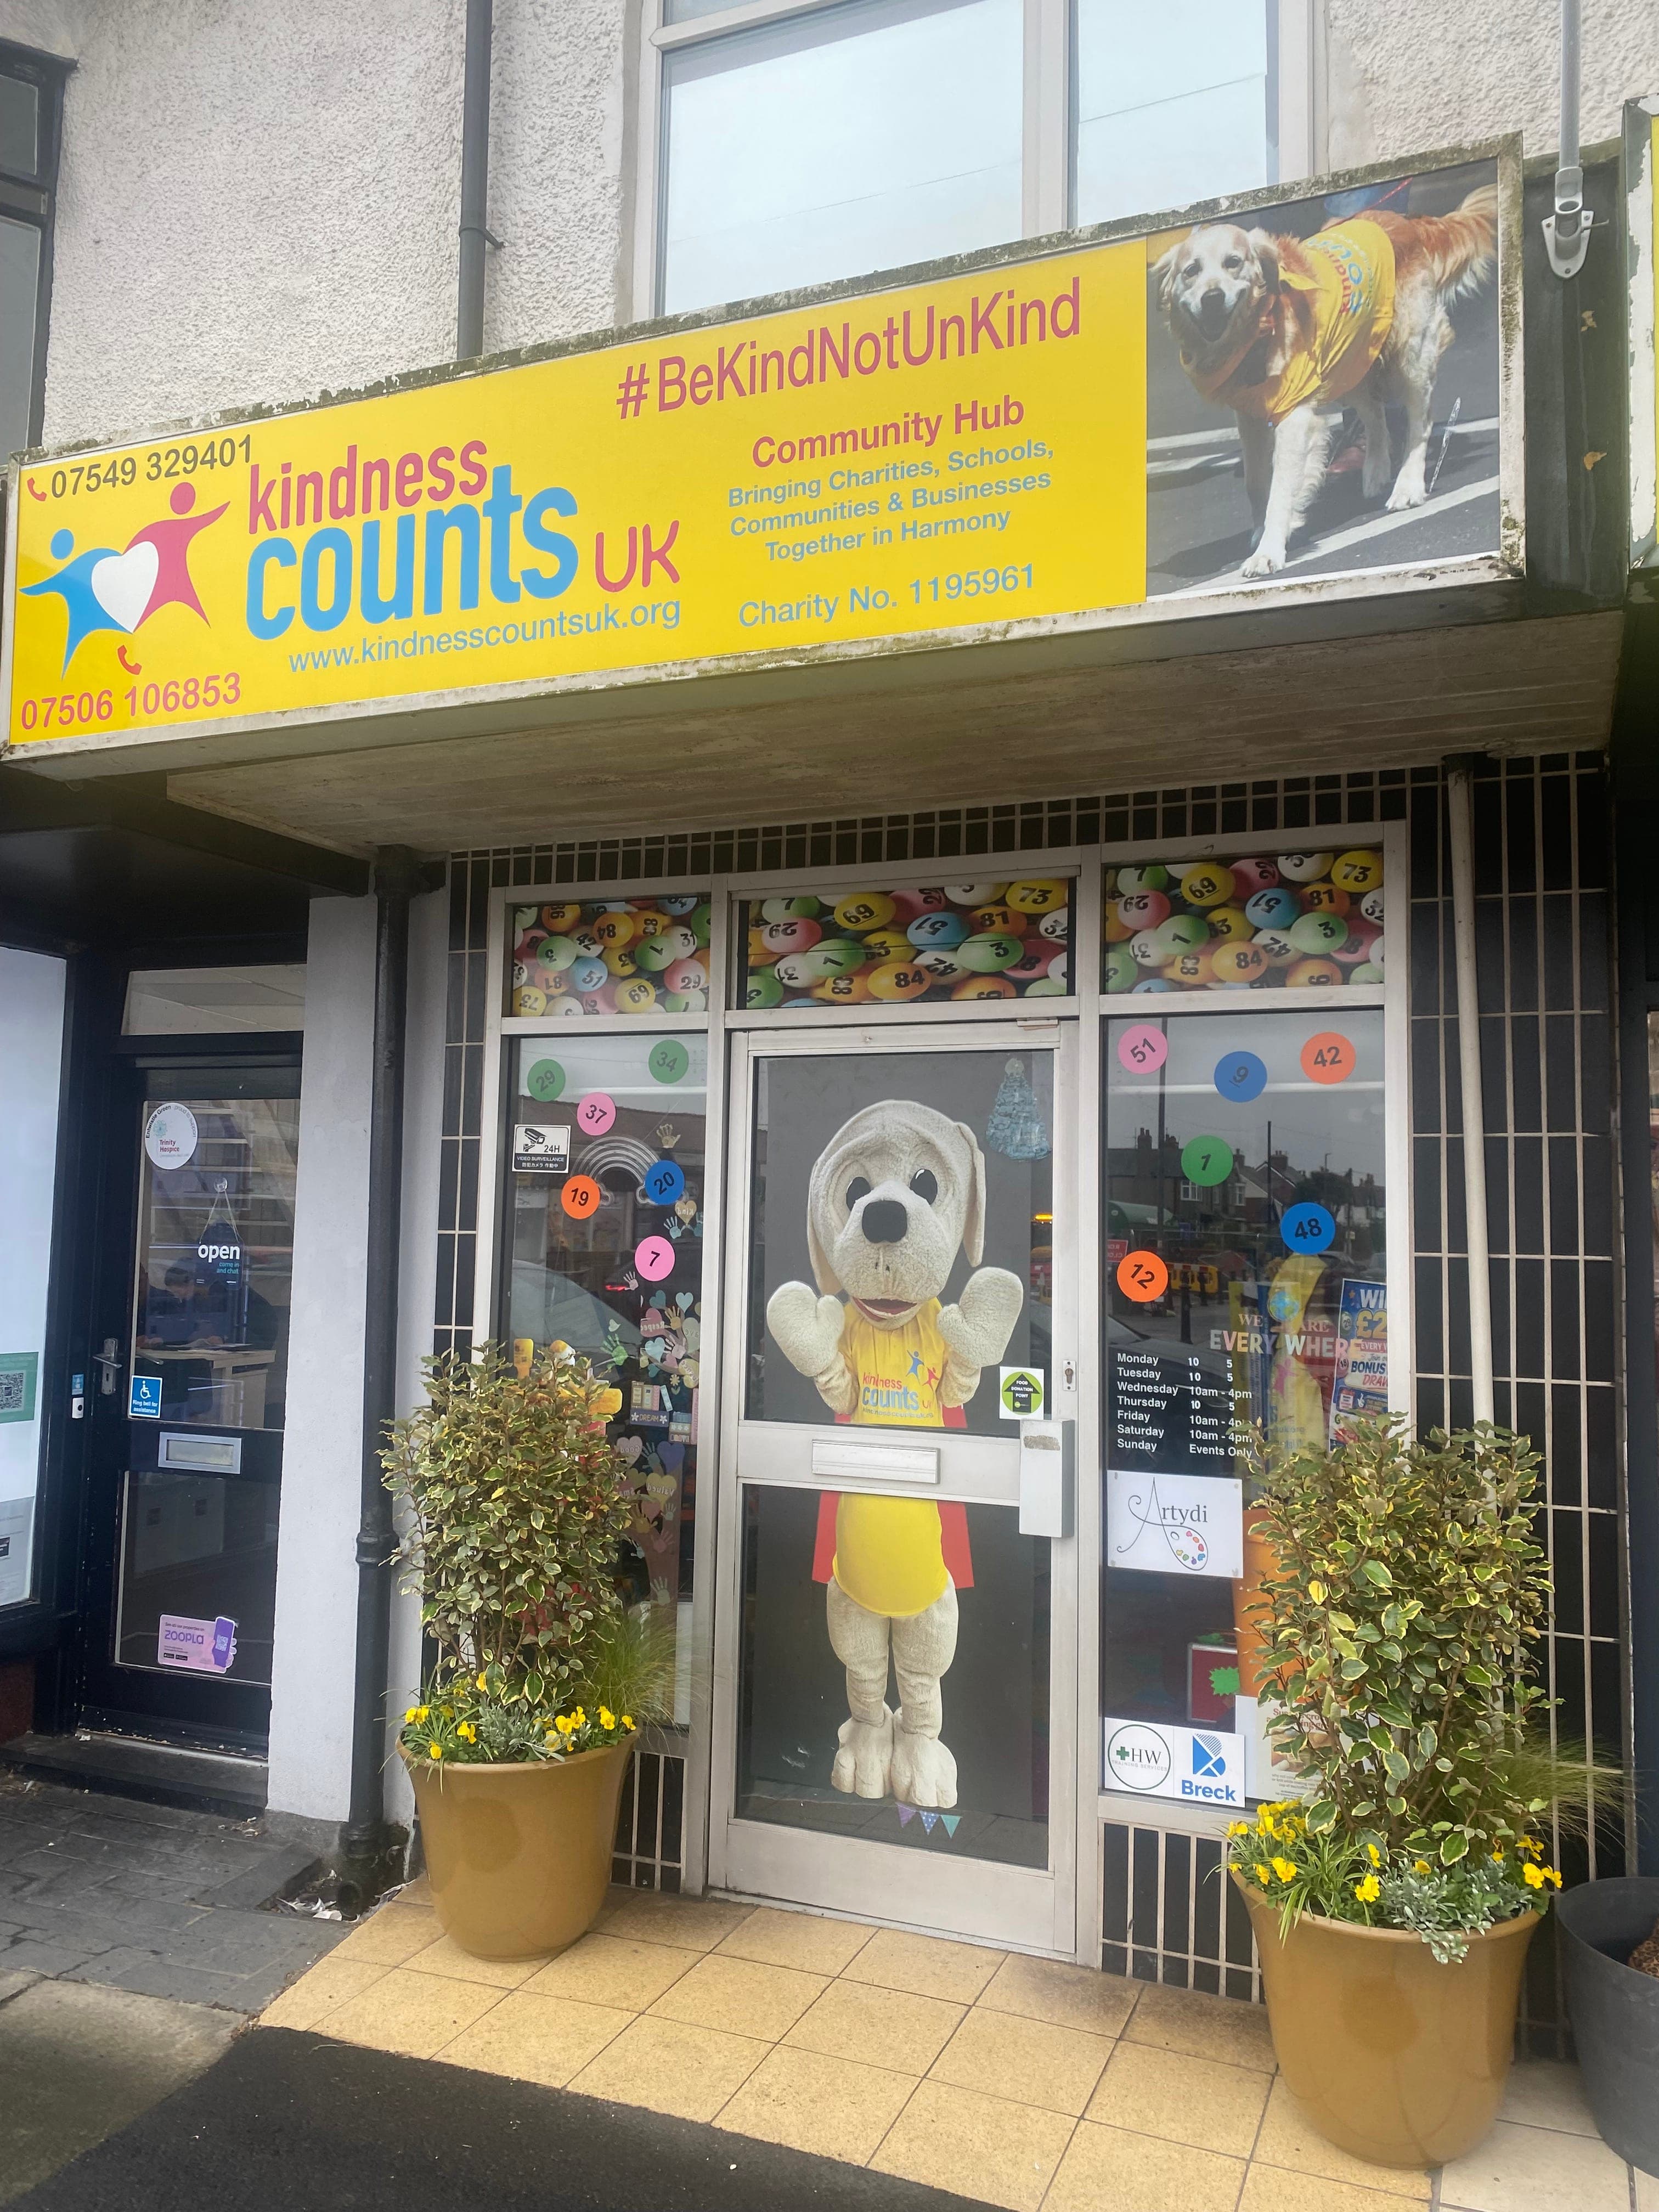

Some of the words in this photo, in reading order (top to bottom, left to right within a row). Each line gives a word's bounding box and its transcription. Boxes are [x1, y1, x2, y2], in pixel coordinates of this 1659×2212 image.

[617, 276, 1081, 420] #BeKindNotUnKind
[753, 413, 943, 468] Community
[955, 394, 1024, 434] Hub
[51, 456, 137, 498] 07549
[146, 434, 252, 482] 329401
[729, 475, 821, 507] Bringing
[829, 456, 940, 492] Charities,
[948, 439, 1053, 472] Schools,
[249, 441, 487, 534] kindness
[730, 499, 879, 536] Communities
[887, 492, 903, 512] &
[912, 471, 1051, 509] Businesses
[765, 534, 865, 562] Together
[873, 526, 893, 544] in
[901, 510, 1011, 540] Harmony
[246, 465, 579, 640] counts
[595, 520, 680, 592] UK
[740, 594, 839, 627] Charity
[850, 586, 898, 613] No.
[909, 563, 1034, 605] 1195961
[289, 600, 681, 672] www.kindnesscountsuk.org
[21, 690, 112, 730] 07506
[124, 672, 241, 717] 106853
[1343, 863, 1372, 882] 73
[1019, 887, 1052, 904] 73
[1124, 895, 1150, 912] 29
[1252, 894, 1281, 913] 51
[1309, 889, 1335, 906] 81
[915, 917, 948, 936] 51
[980, 911, 1009, 927] 81
[597, 923, 617, 940] 84
[680, 933, 696, 947] 31
[769, 922, 798, 939] 29
[1318, 922, 1336, 939] 3
[576, 933, 597, 951] 42
[989, 942, 1009, 957] 3
[1132, 943, 1151, 959] 31
[545, 949, 557, 964] 3
[1235, 950, 1261, 969] 84
[545, 975, 563, 990] 81
[582, 970, 603, 988] 51
[680, 974, 701, 990] 29
[777, 966, 799, 982] 31
[895, 970, 925, 989] 84
[519, 994, 539, 1011] 73
[1130, 1038, 1156, 1063] 51
[1313, 1046, 1342, 1067] 42
[657, 1051, 678, 1071] 34
[536, 1071, 555, 1092] 29
[1229, 1066, 1249, 1088] 9
[145, 1114, 157, 1138] Entwistle
[157, 1105, 171, 1115] Green
[586, 1104, 607, 1124] 37
[1200, 1154, 1212, 1171] 1
[654, 1171, 675, 1195] 20
[571, 1188, 589, 1206] 19
[1294, 1218, 1322, 1240] 48
[198, 1244, 240, 1263] open
[649, 1251, 660, 1267] 7
[1130, 1263, 1155, 1290] 12
[1238, 1313, 1263, 1327] WE
[1299, 1319, 1330, 1333] ARE
[1210, 1329, 1278, 1355] EVERY
[1361, 1342, 1382, 1351] EVERY
[1118, 1353, 1159, 1366] Monday
[1188, 1357, 1199, 1367] 10
[1226, 1359, 1233, 1368] 5
[1351, 1361, 1386, 1374] BONUS
[862, 1372, 902, 1390] kindness
[1117, 1367, 1161, 1381] Tuesday
[1189, 1373, 1201, 1381] 10
[1227, 1373, 1233, 1382] 5
[862, 1386, 919, 1410] counts
[1117, 1381, 1178, 1396] Wednesday
[1190, 1386, 1218, 1397] 10am
[1228, 1388, 1252, 1401] 4pm
[1117, 1396, 1167, 1409] Thursday
[1191, 1400, 1201, 1409] 10
[1229, 1402, 1234, 1411] 5
[639, 1414, 658, 1422] DREAM
[1118, 1410, 1150, 1423] Friday
[1190, 1415, 1218, 1426] 10am
[1118, 1425, 1164, 1438] Saturday
[1190, 1430, 1218, 1441] 10am
[1228, 1432, 1252, 1444] 4pm
[1118, 1439, 1157, 1452] Sunday
[1189, 1444, 1225, 1456] Events
[165, 1629, 204, 1645] zoopla
[1131, 1748, 1161, 1765] HW
[1140, 1763, 1168, 1771] SERVICES
[1181, 1780, 1237, 1802] Breck
